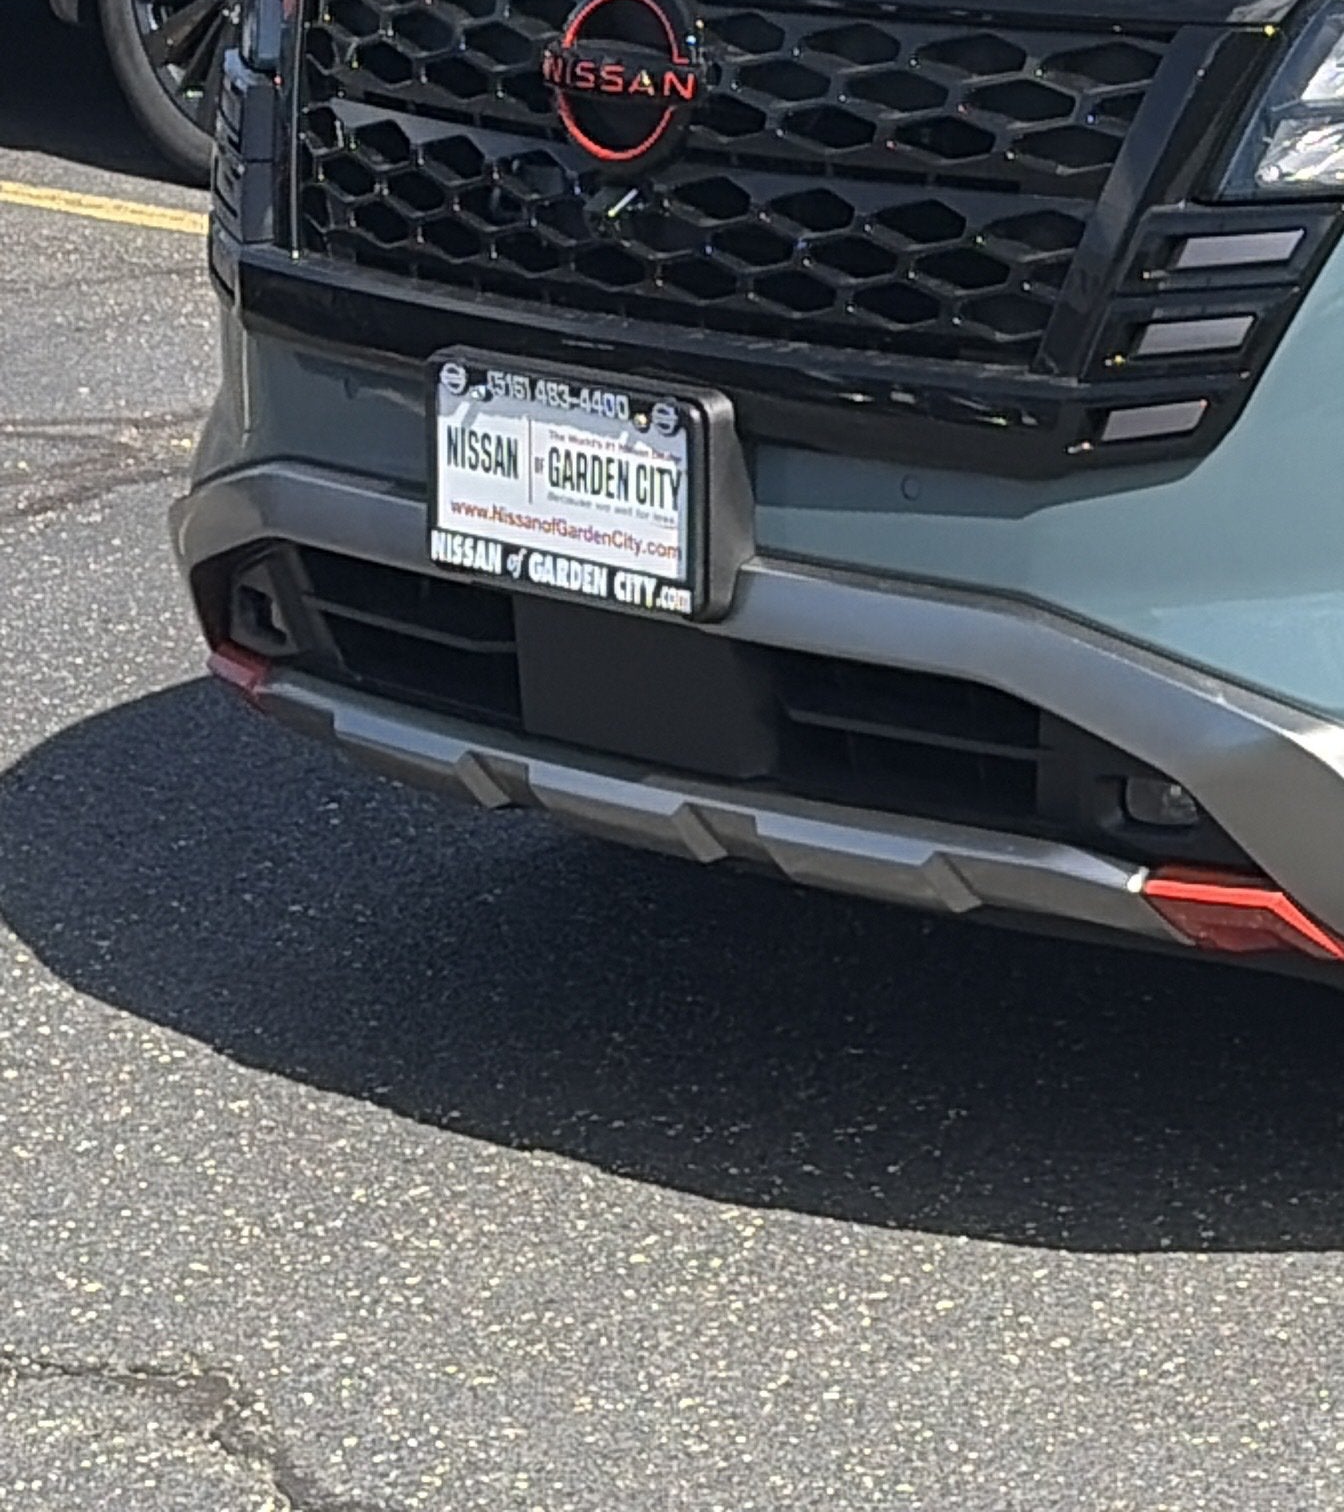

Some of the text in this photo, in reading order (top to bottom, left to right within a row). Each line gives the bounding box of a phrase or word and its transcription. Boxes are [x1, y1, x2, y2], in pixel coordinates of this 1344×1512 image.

[543, 51, 695, 100] NISSAN
[534, 379, 630, 421] 483-4400
[446, 425, 682, 512] NISSAN OF GARDEN CITY
[450, 500, 680, 561] www.NissanofGardenCity.com
[430, 529, 502, 575] NISSAN
[507, 548, 528, 579] of
[528, 552, 609, 598] GARDEN
